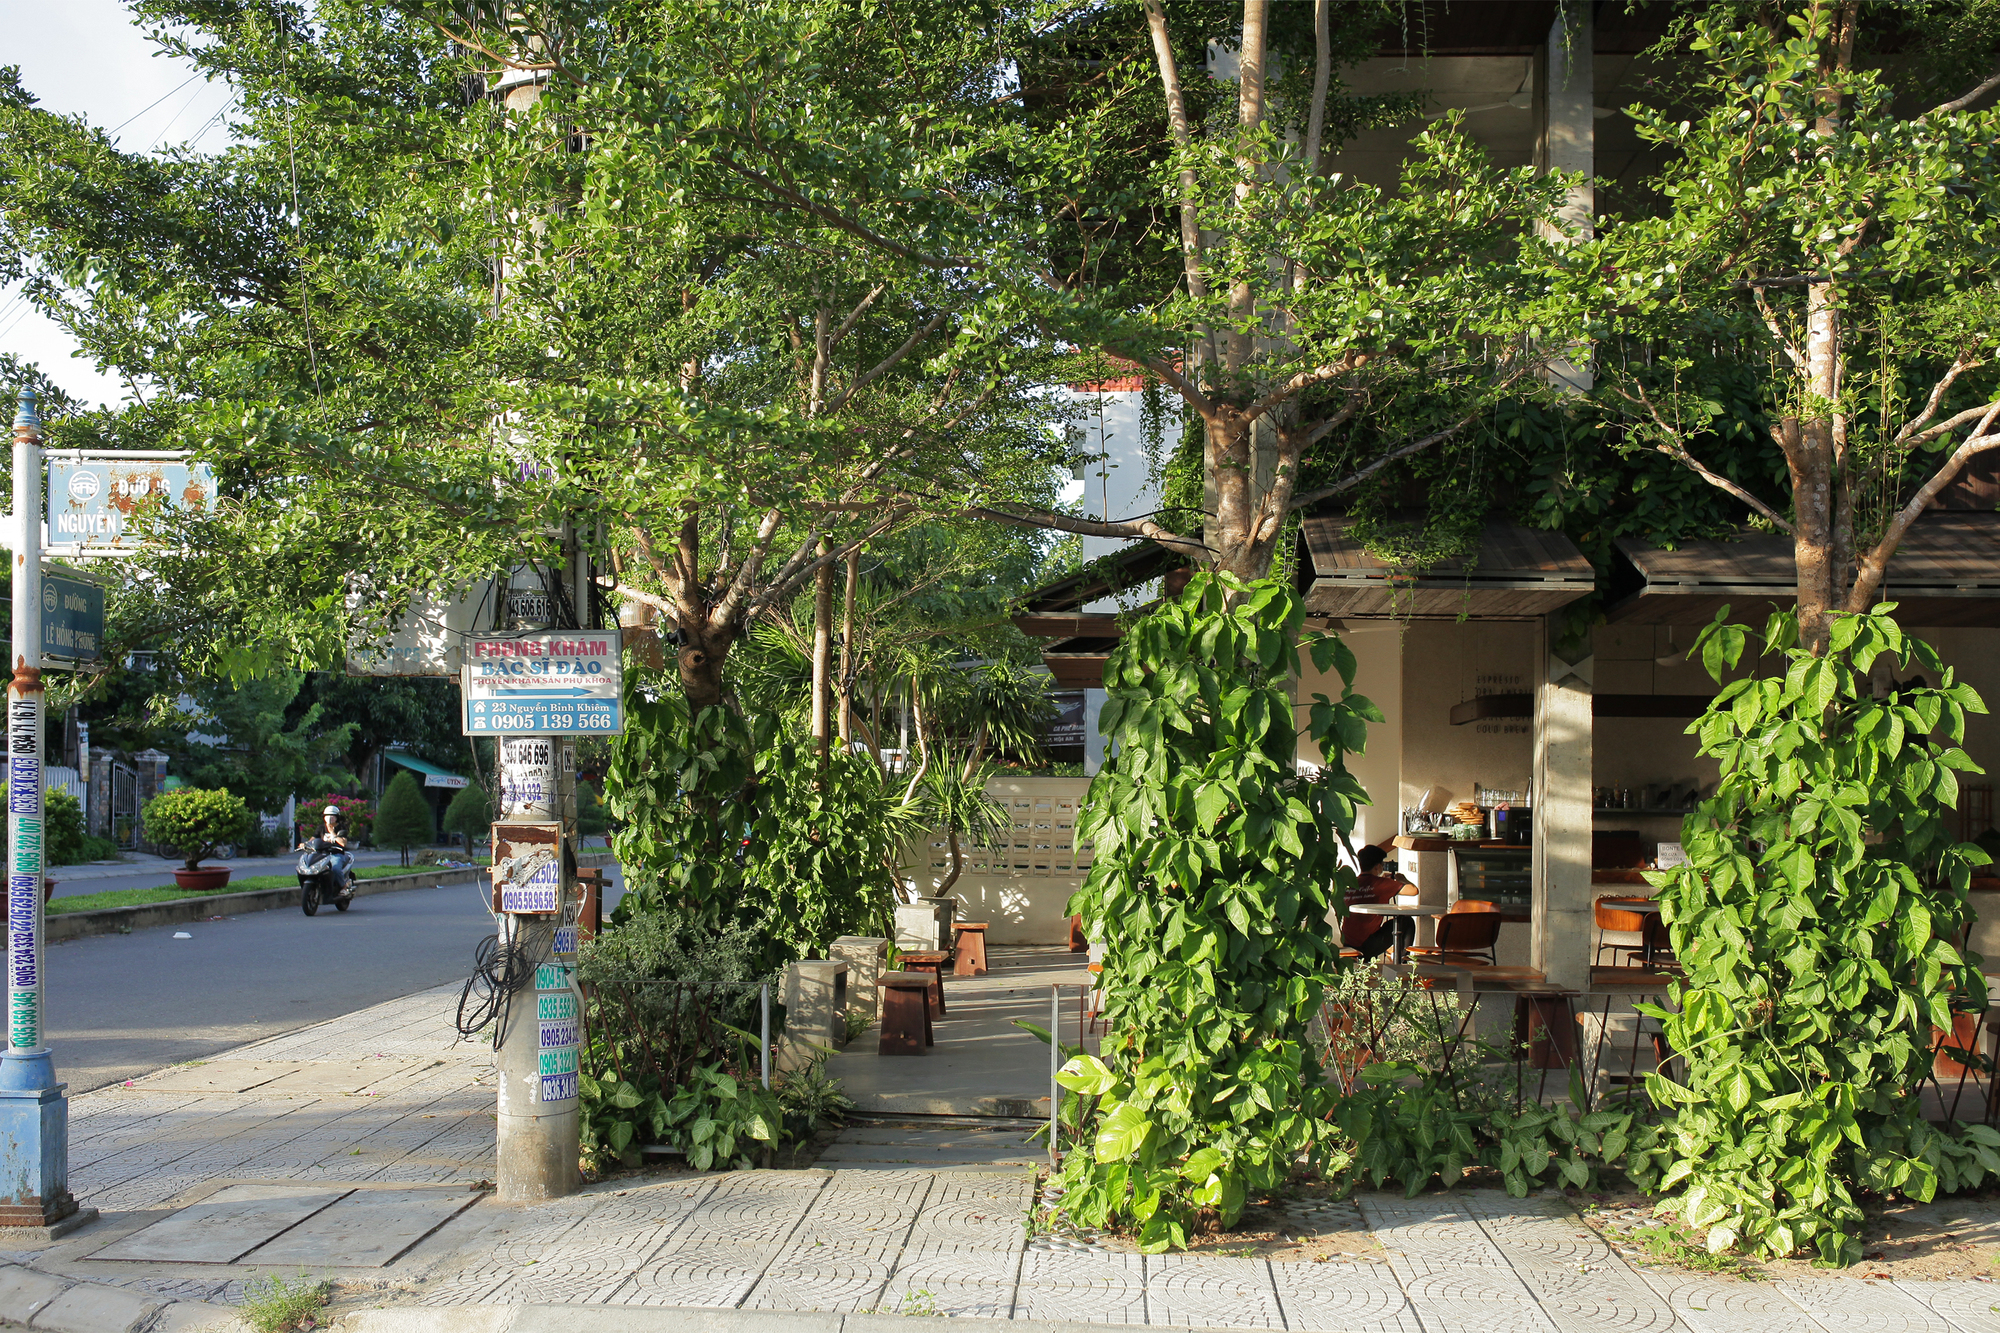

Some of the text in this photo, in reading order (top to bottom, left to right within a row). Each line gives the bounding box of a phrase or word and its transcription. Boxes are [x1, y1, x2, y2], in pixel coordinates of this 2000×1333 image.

[118, 475, 171, 495] ĐƯỜG
[57, 506, 117, 533] NGUYỄN
[64, 592, 87, 613] ĐƯỜNG
[45, 621, 54, 644] LÊ
[56, 620, 74, 648] HỒNG
[475, 638, 607, 657] PHÒNG KHÁM
[481, 657, 602, 675] BÁC SĨ ĐÀO
[511, 677, 540, 685] KHÁM
[1477, 675, 1520, 685] ESPRESSO
[491, 702, 507, 712] 23
[509, 702, 547, 714] Nguyễn
[577, 703, 610, 712] Khiêm
[12, 701, 36, 754] 0934.71.16.71
[491, 714, 611, 729] 0905 139 566
[1477, 725, 1498, 733] COLD
[14, 759, 38, 813] 0936.34.05.05
[16, 817, 41, 872] 0905.322.007
[10, 876, 34, 932] 0935.62.50.22
[503, 891, 553, 909] 0905.58.96.58
[13, 932, 36, 987] 0905.234.332
[13, 992, 37, 1047] 0935.558.345
